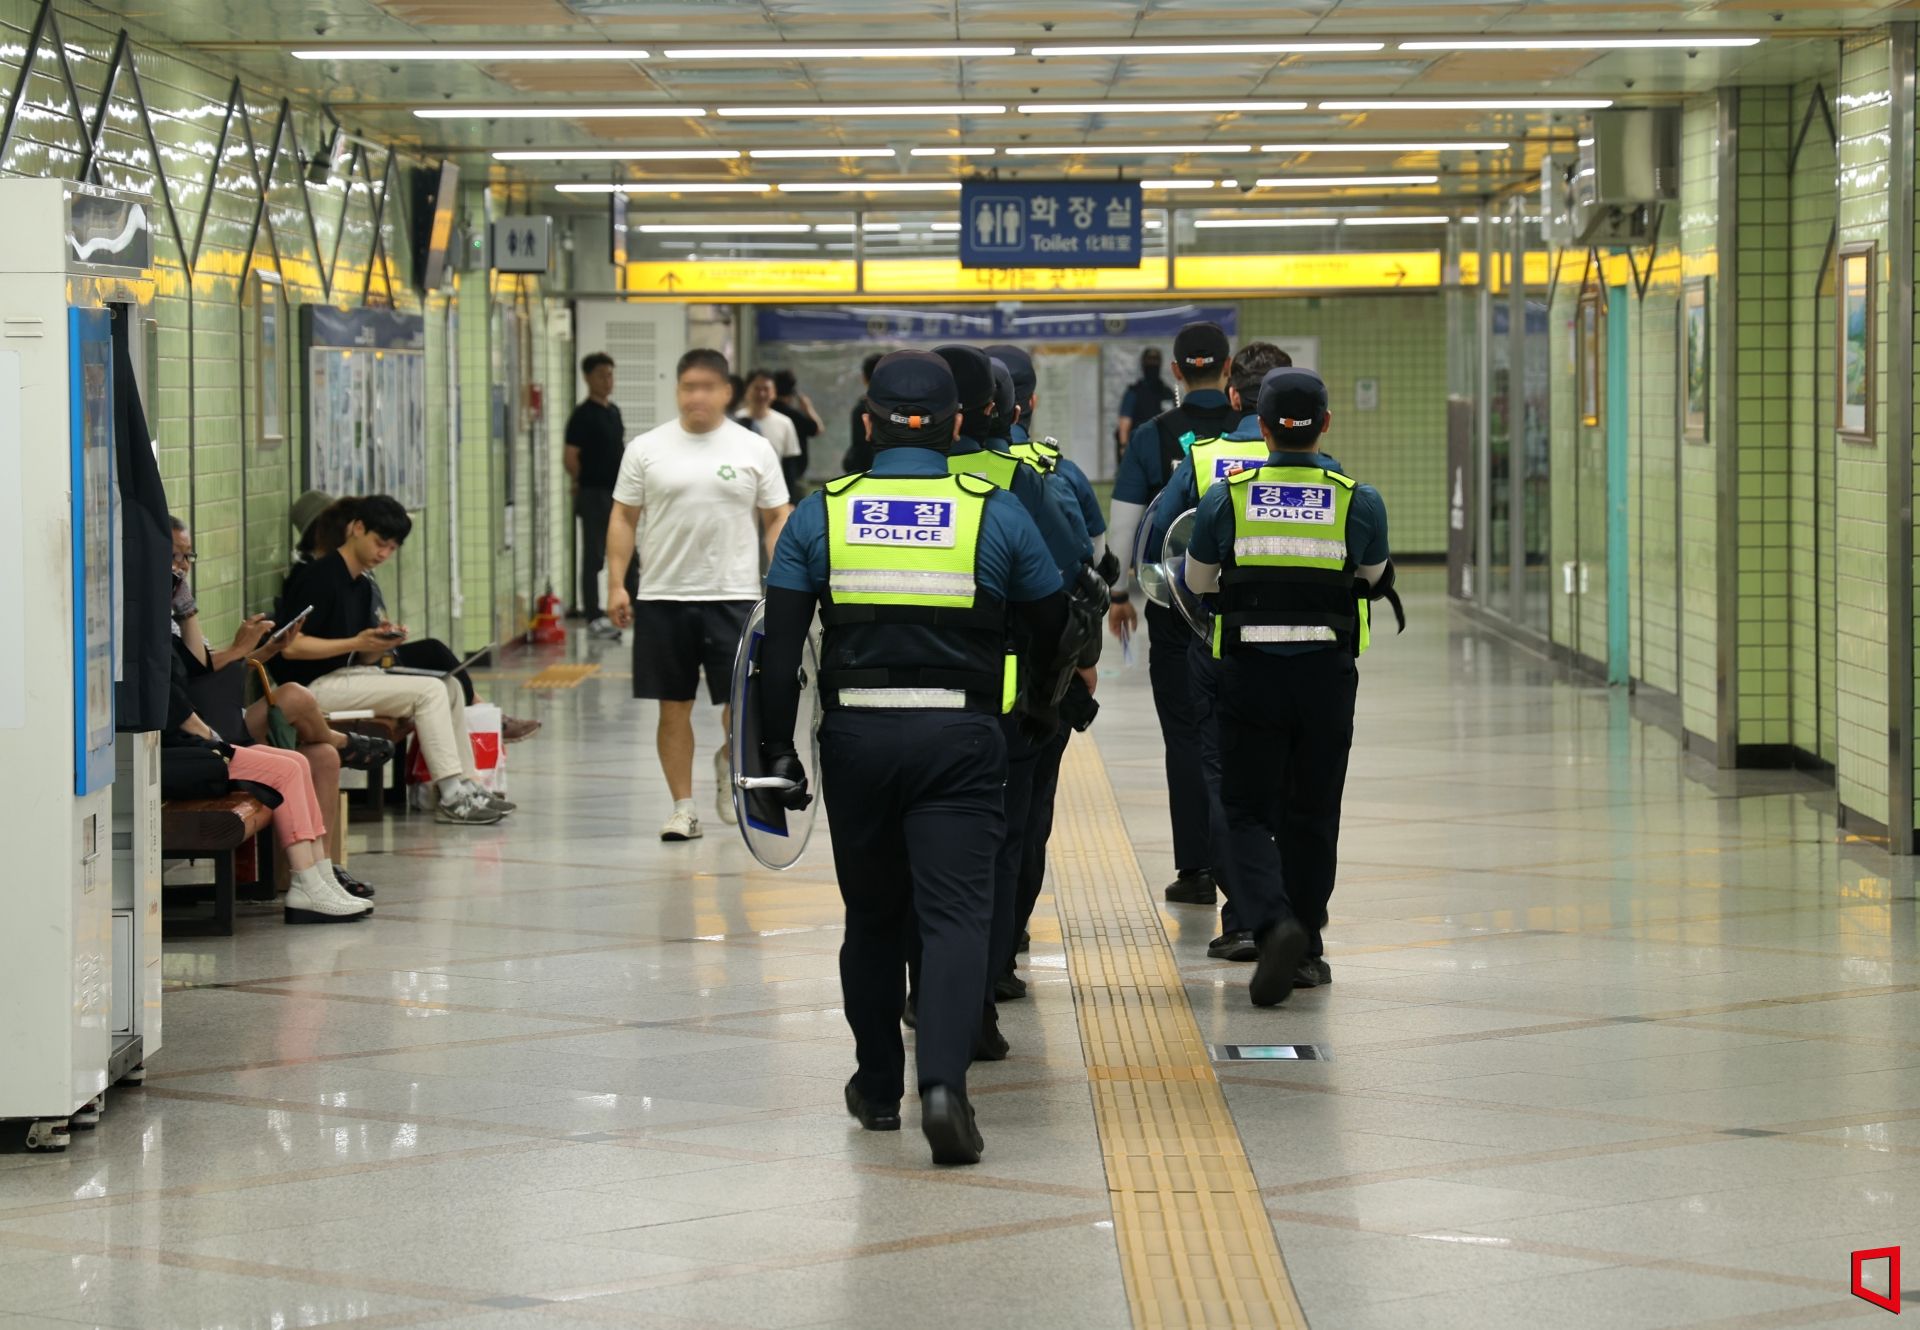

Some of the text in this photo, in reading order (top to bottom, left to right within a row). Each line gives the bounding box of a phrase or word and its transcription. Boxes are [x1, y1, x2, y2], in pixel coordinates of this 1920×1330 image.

[1030, 196, 1132, 229] 화장실
[1031, 233, 1079, 252] Toilet
[1259, 486, 1325, 507] 경찰
[861, 501, 944, 525] 경찰
[1256, 507, 1324, 520] POLICE
[859, 527, 942, 541] POLICE
